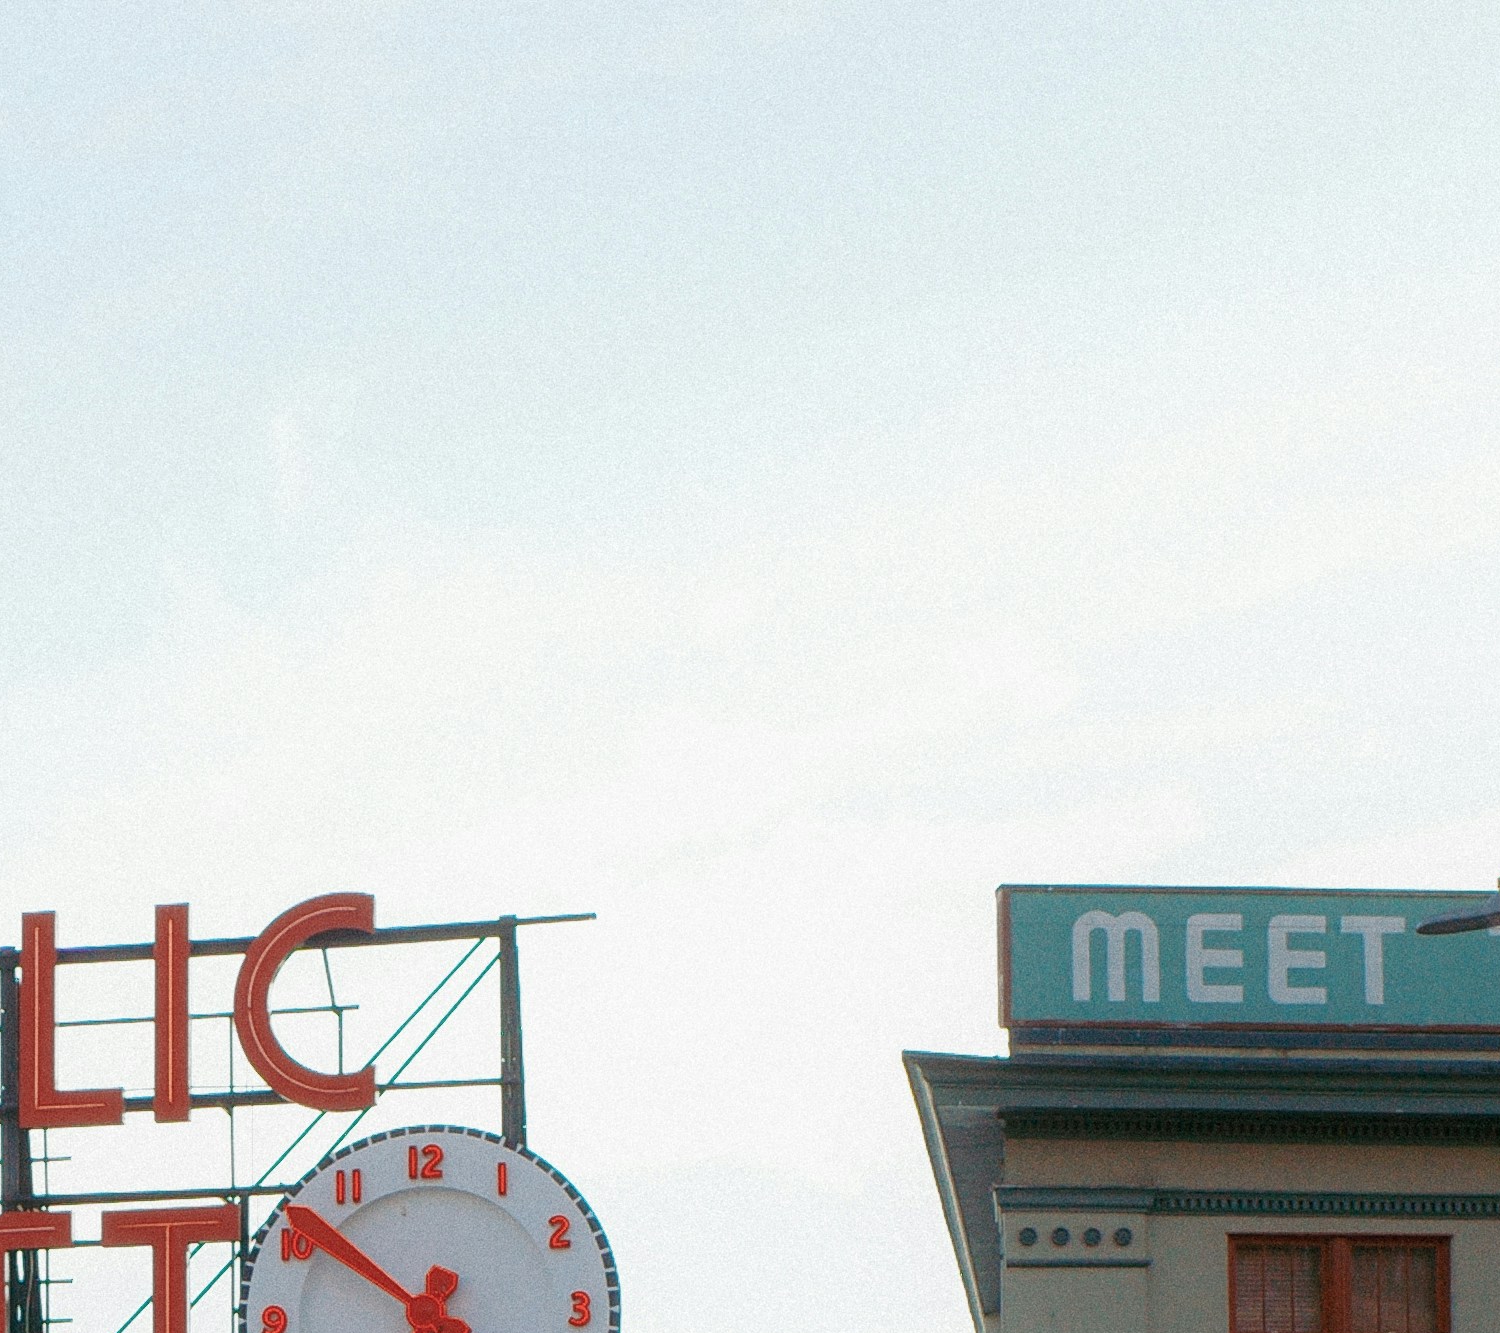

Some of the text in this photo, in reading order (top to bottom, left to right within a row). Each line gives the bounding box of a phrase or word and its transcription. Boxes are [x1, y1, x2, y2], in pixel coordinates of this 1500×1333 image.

[1071, 909, 1405, 1005] MEET
[408, 1144, 444, 1179] 12
[497, 1162, 508, 1196] 1
[335, 1169, 361, 1204] 11
[281, 1227, 314, 1261] 10
[549, 1215, 571, 1249] 2
[569, 1290, 591, 1327] 3
